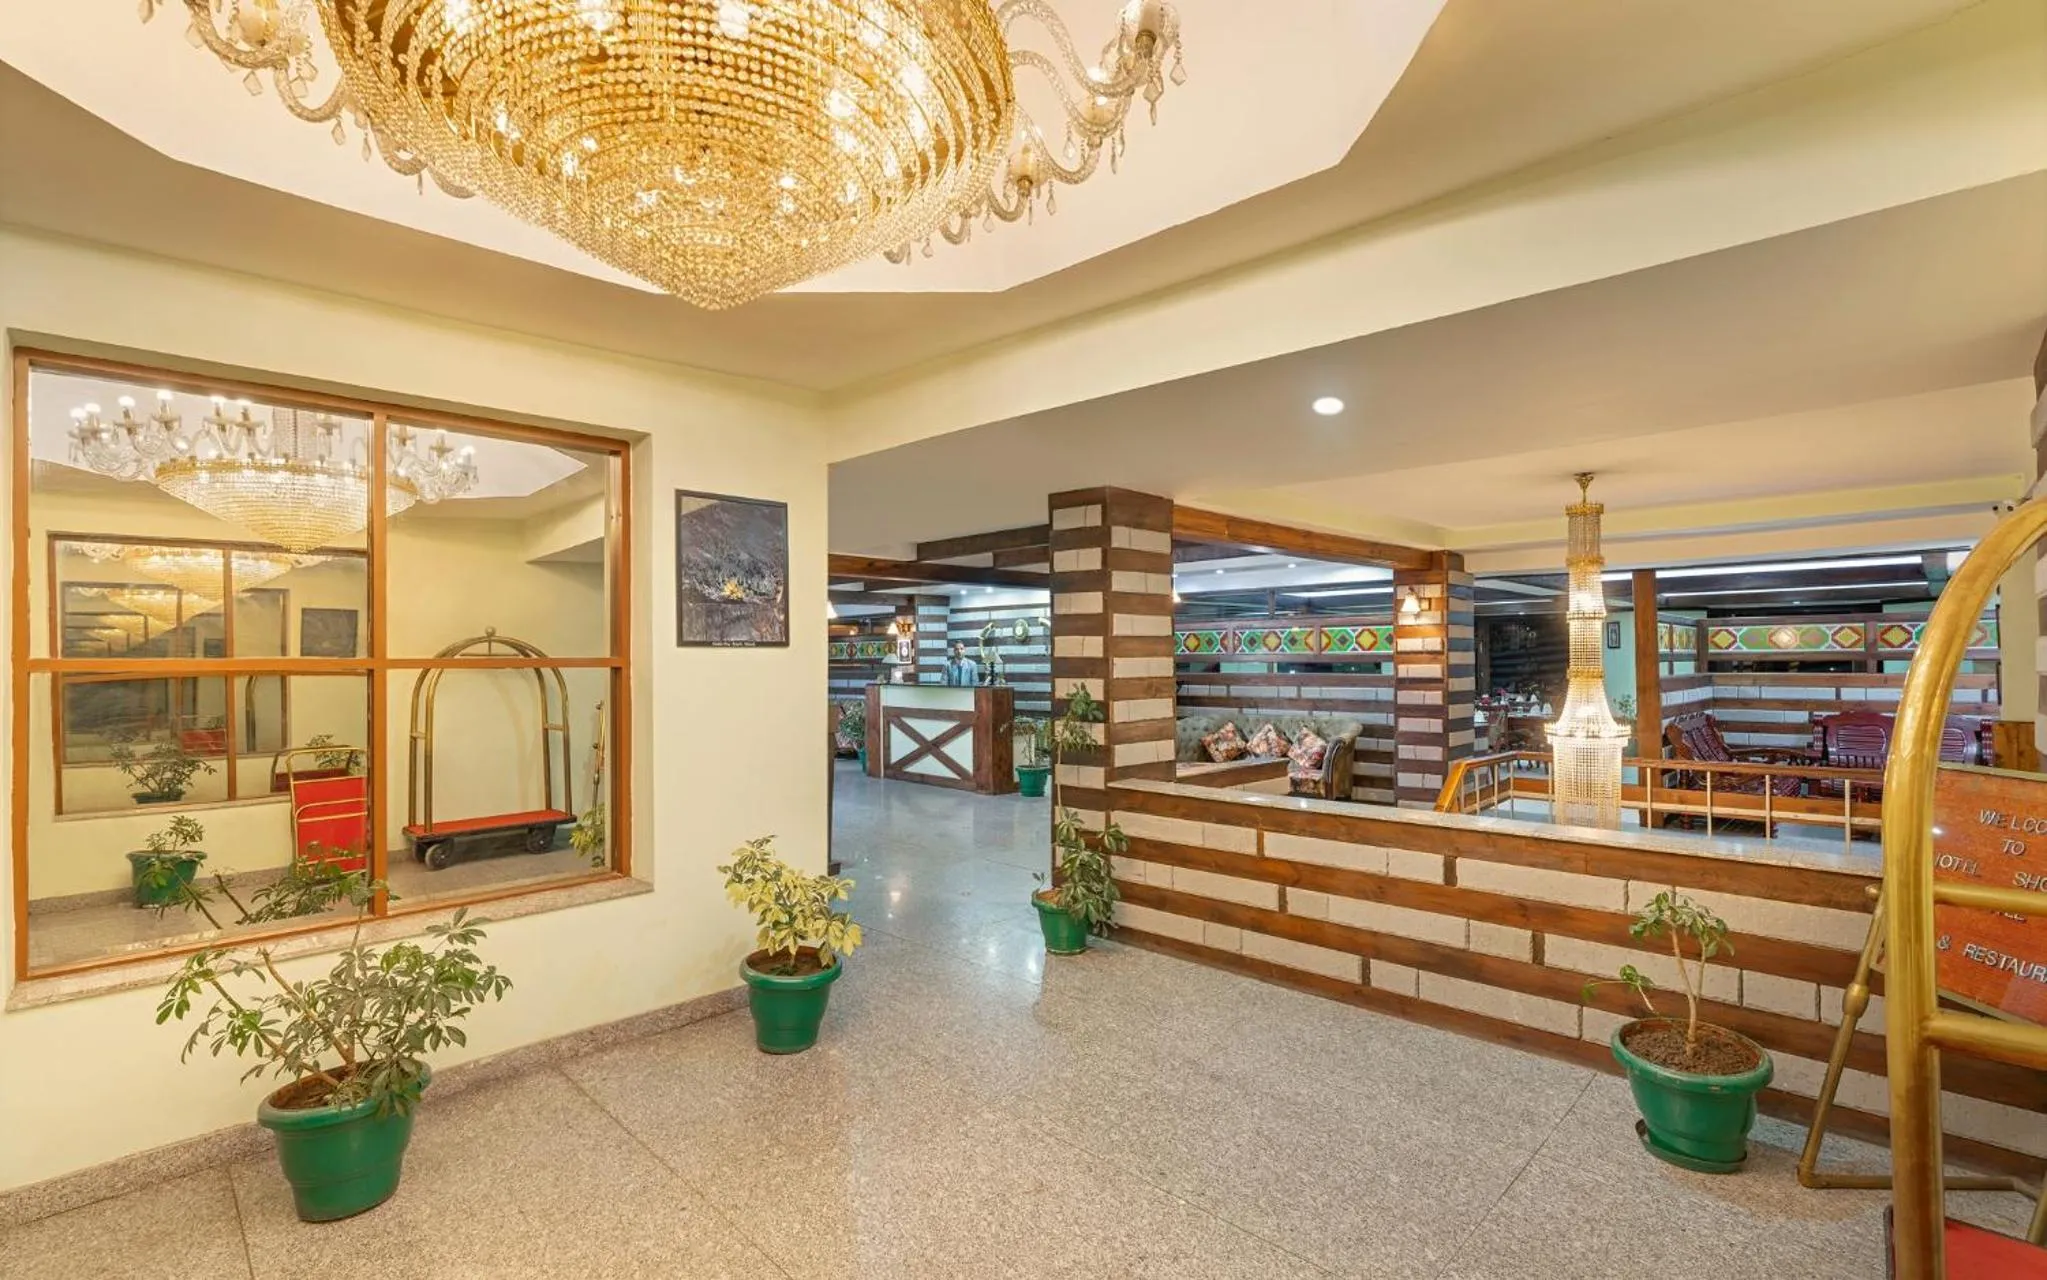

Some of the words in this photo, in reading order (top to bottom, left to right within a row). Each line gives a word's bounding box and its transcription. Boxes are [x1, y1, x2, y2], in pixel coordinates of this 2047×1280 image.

[2002, 838, 2025, 856] TO
[1937, 935, 1951, 950] &
[1963, 943, 2047, 983] RESTAUR
